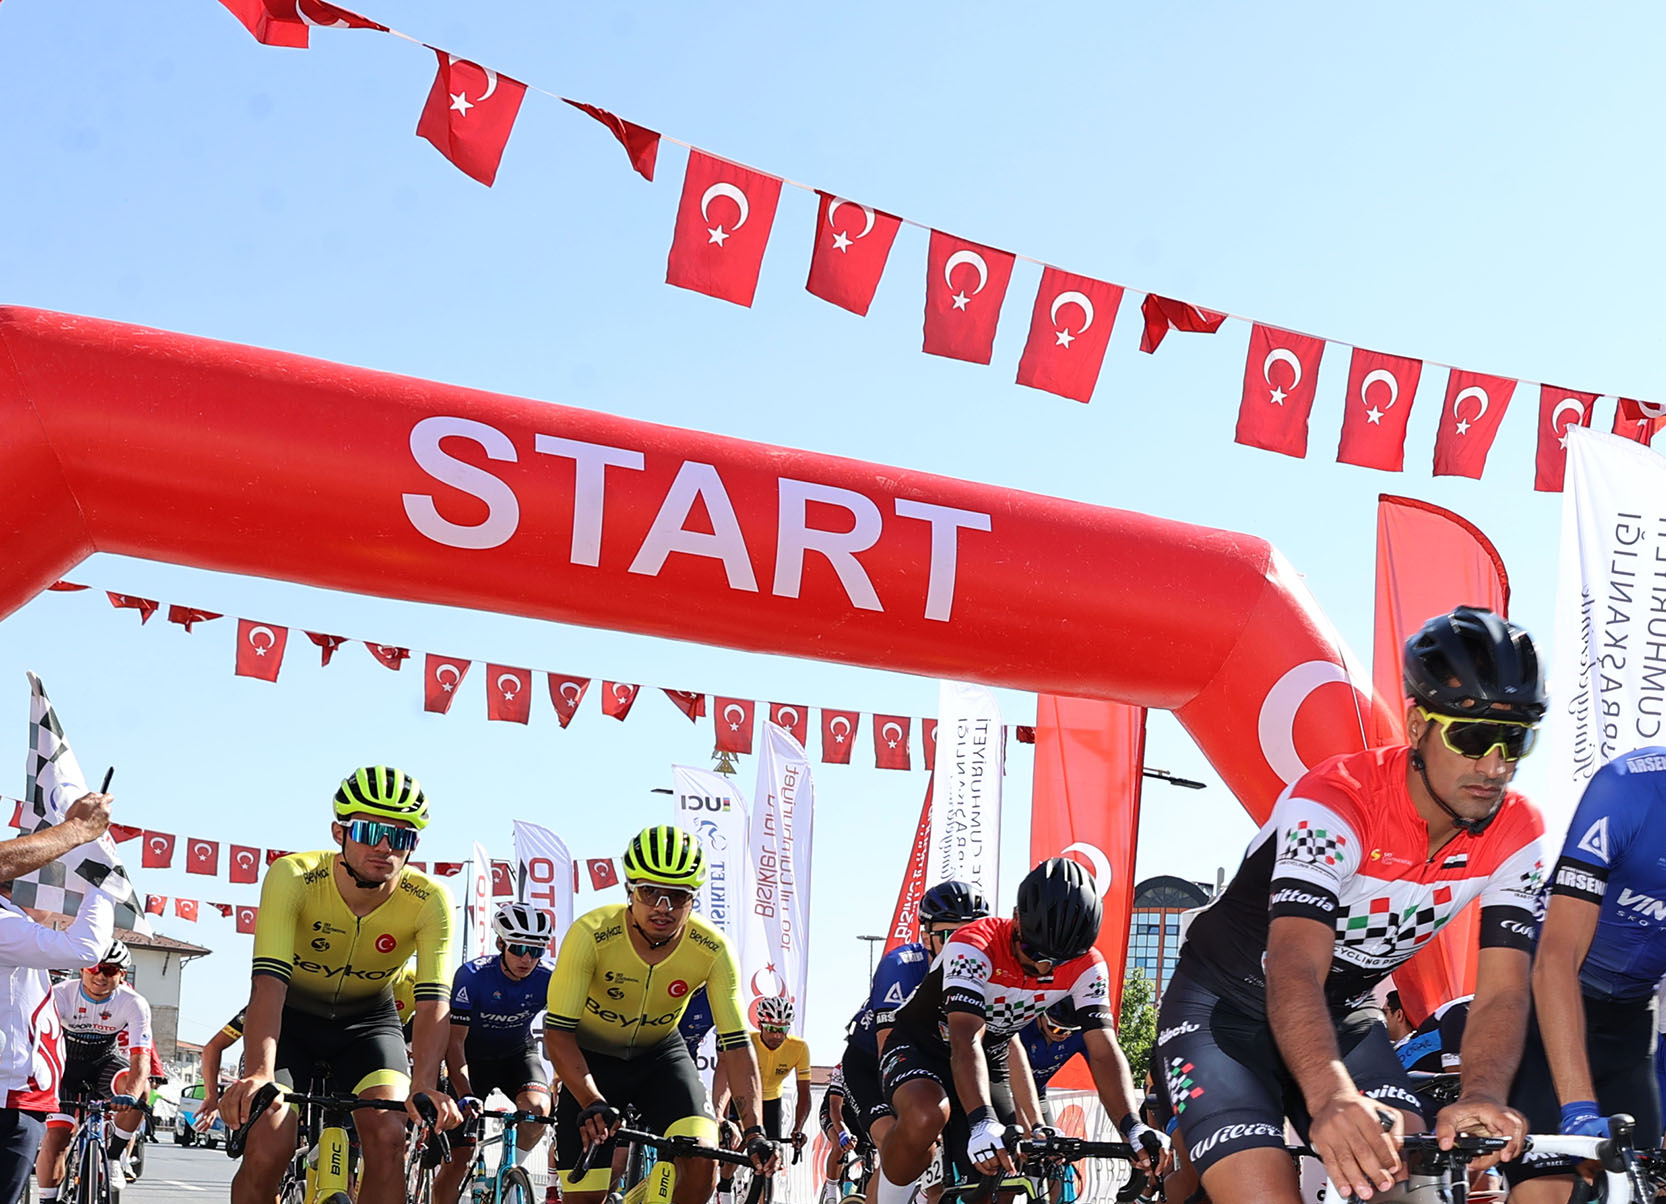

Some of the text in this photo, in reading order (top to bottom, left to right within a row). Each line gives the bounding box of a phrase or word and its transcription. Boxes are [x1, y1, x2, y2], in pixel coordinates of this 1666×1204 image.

[402, 416, 993, 622] START
[1555, 869, 1607, 897] ARSEN
[1271, 888, 1336, 913] vittoria
[584, 996, 683, 1028] Beykoz
[330, 1142, 342, 1176] BMC
[659, 1167, 671, 1198] BMC
